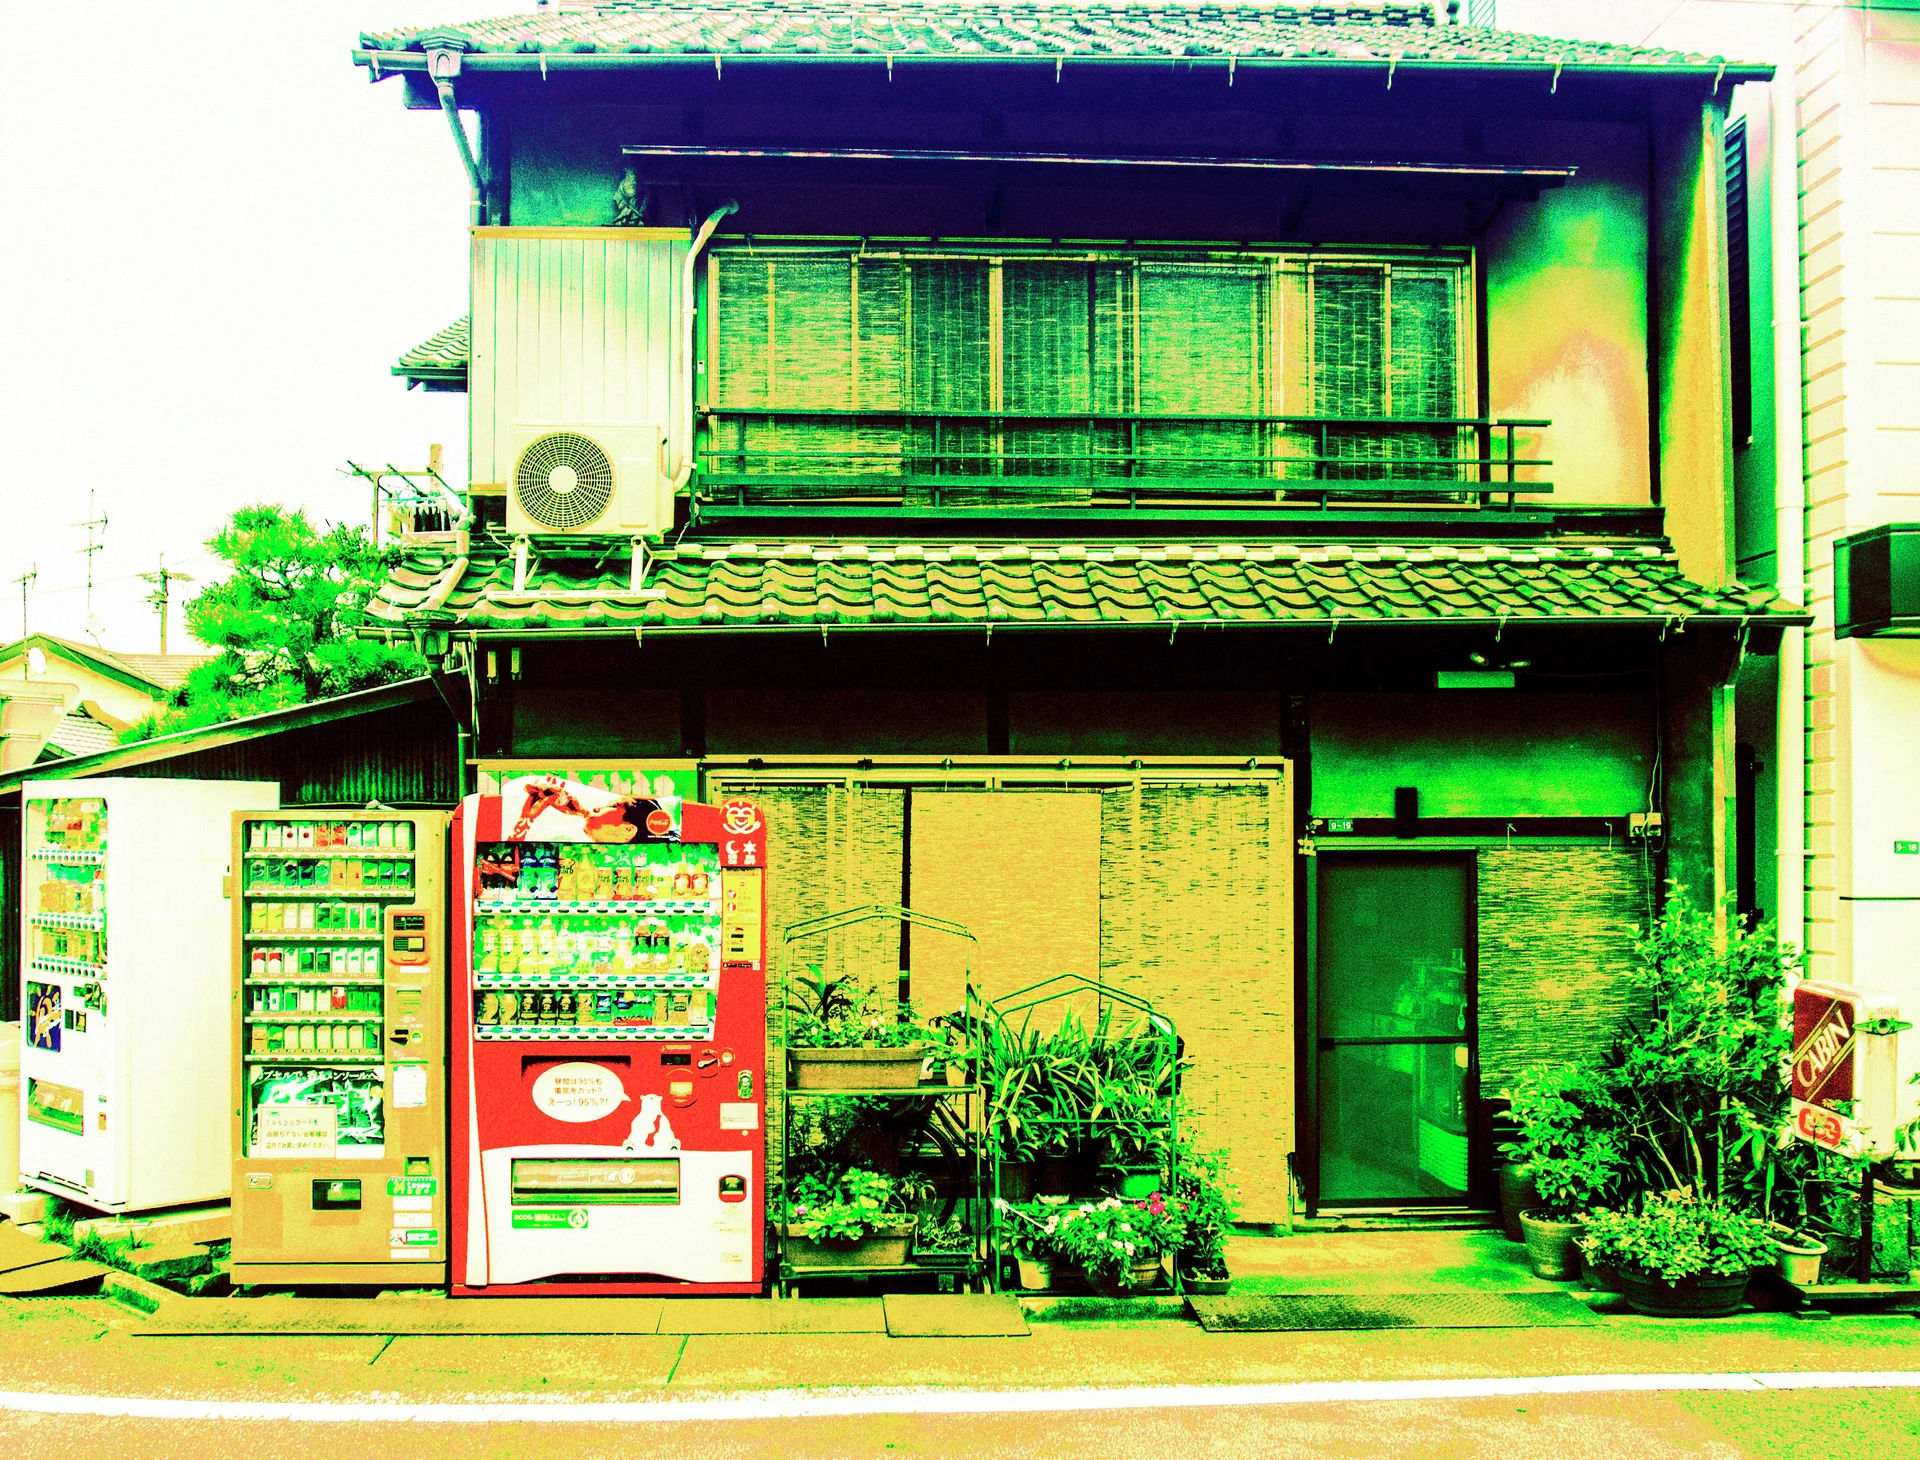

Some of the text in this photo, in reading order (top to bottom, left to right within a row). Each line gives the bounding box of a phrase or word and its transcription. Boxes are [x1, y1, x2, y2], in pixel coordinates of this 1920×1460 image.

[1331, 821, 1352, 830] 9-19
[1897, 843, 1917, 852] 9-18
[1797, 1009, 1850, 1087] CABIN
